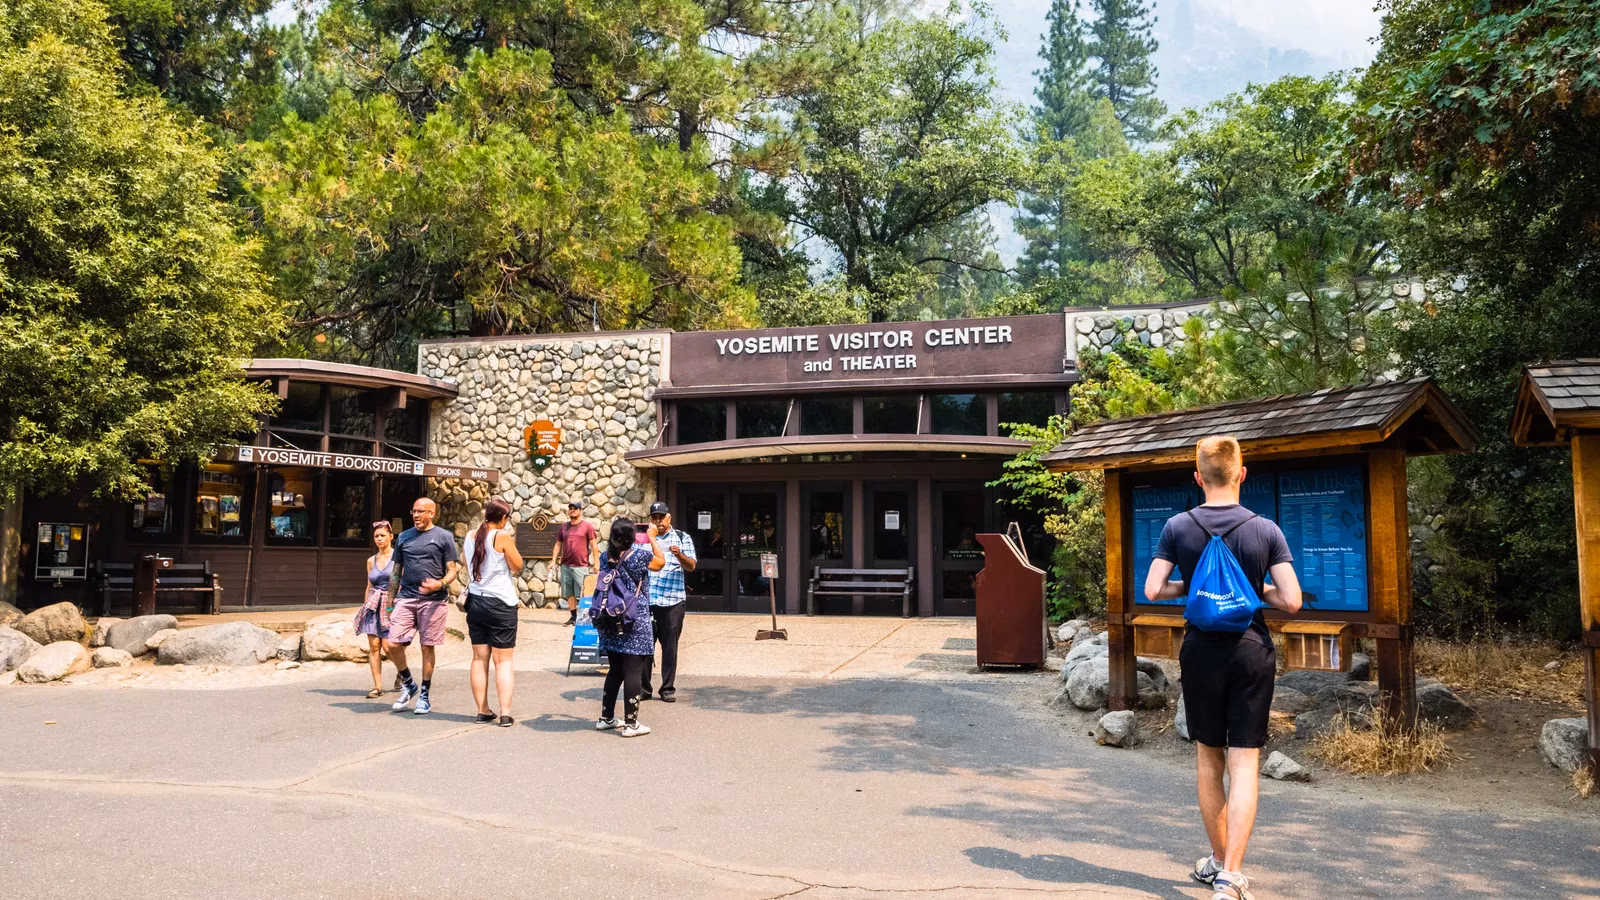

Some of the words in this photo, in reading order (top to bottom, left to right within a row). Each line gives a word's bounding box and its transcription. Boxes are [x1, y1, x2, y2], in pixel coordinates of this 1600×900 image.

[716, 334, 819, 355] YOSEMITE
[829, 330, 914, 351] VISITOR
[924, 325, 1013, 347] CENTER
[803, 357, 833, 372] and
[840, 354, 917, 371] THEATER
[257, 450, 332, 467] YOSEMITE
[334, 456, 412, 474] BOOKSTORE
[437, 466, 461, 477] BOOKS
[471, 470, 488, 479] MAPS
